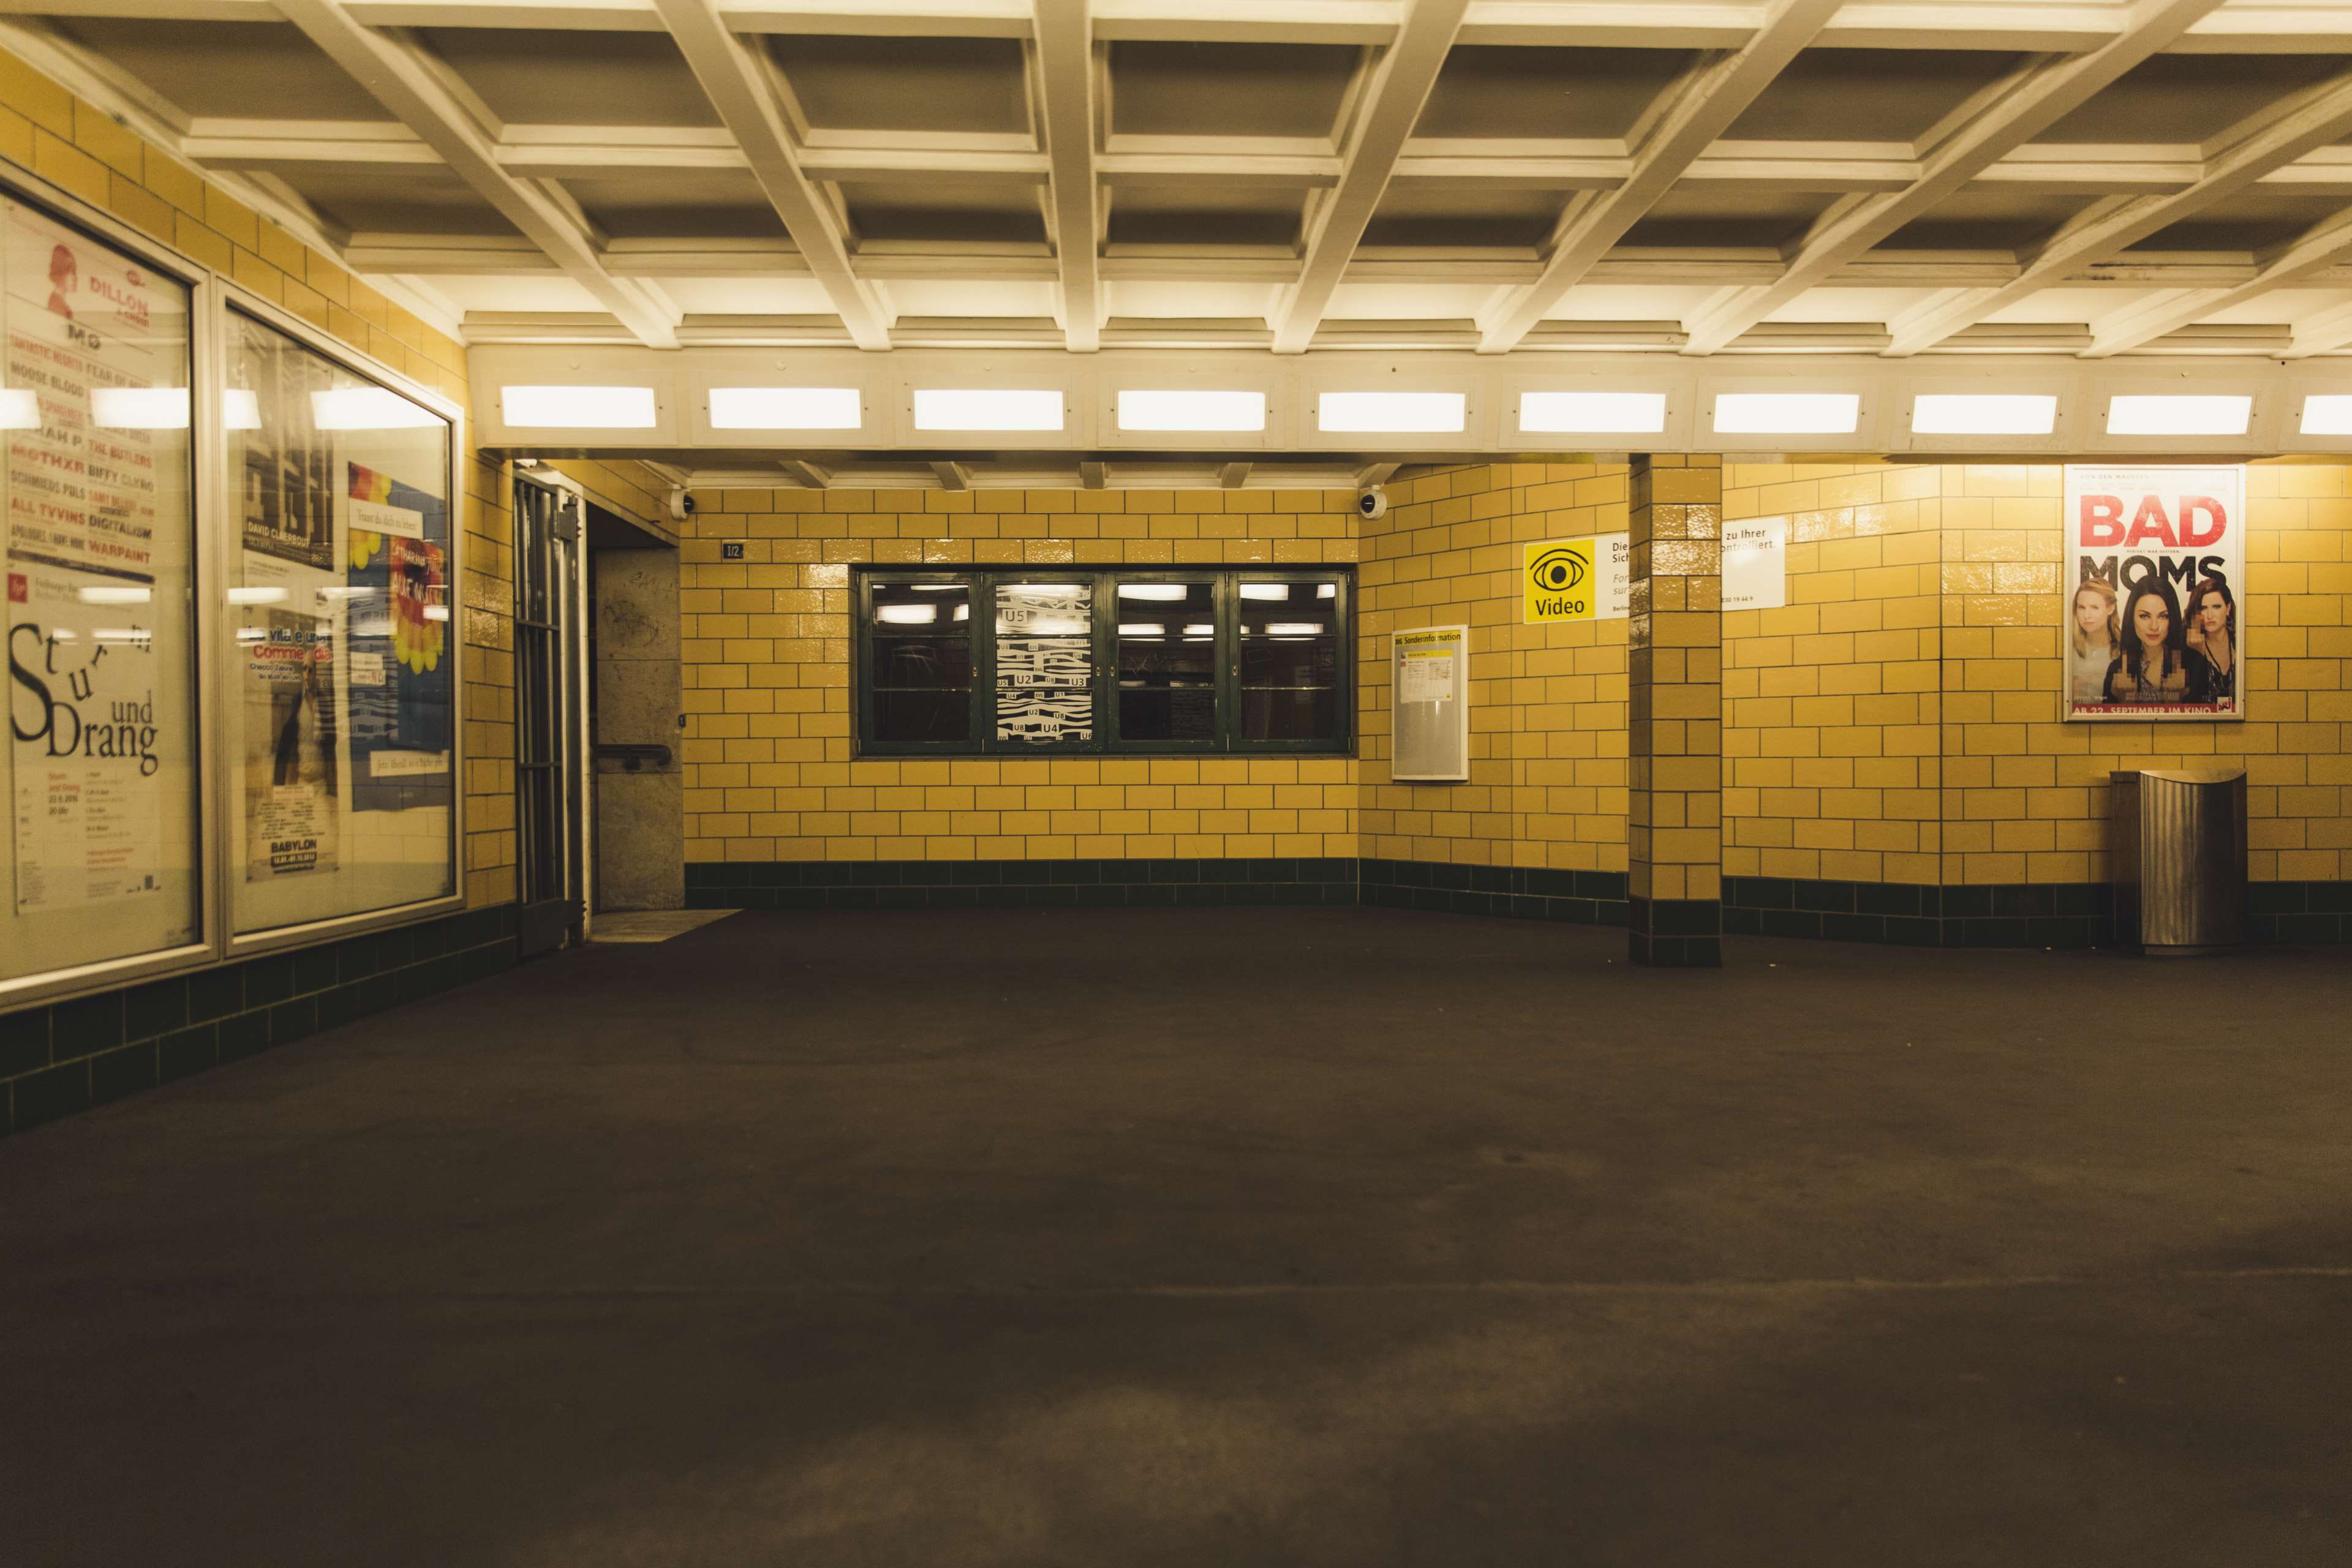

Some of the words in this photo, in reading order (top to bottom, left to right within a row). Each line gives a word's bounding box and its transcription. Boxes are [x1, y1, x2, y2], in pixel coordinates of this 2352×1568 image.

[90, 275, 148, 317] DILLON
[88, 464, 118, 483] BIFFY
[11, 497, 35, 514] ALL
[89, 515, 153, 540] DIGITALISM
[2080, 495, 2227, 547] BAD
[248, 522, 270, 537] DAVID
[271, 529, 310, 548] CLAERBOUT
[1741, 529, 1766, 539] Ihrer
[89, 539, 151, 564] WARPAINT
[1613, 542, 1627, 551] Die
[2080, 555, 2227, 592] MOMS
[1006, 610, 1025, 622] U5
[1536, 597, 1585, 616] Video
[1404, 633, 1461, 644] Sonderinformation
[1017, 675, 1031, 684] U2
[111, 688, 154, 725] und
[45, 701, 159, 777] Drang
[271, 838, 317, 853] BABYLON
